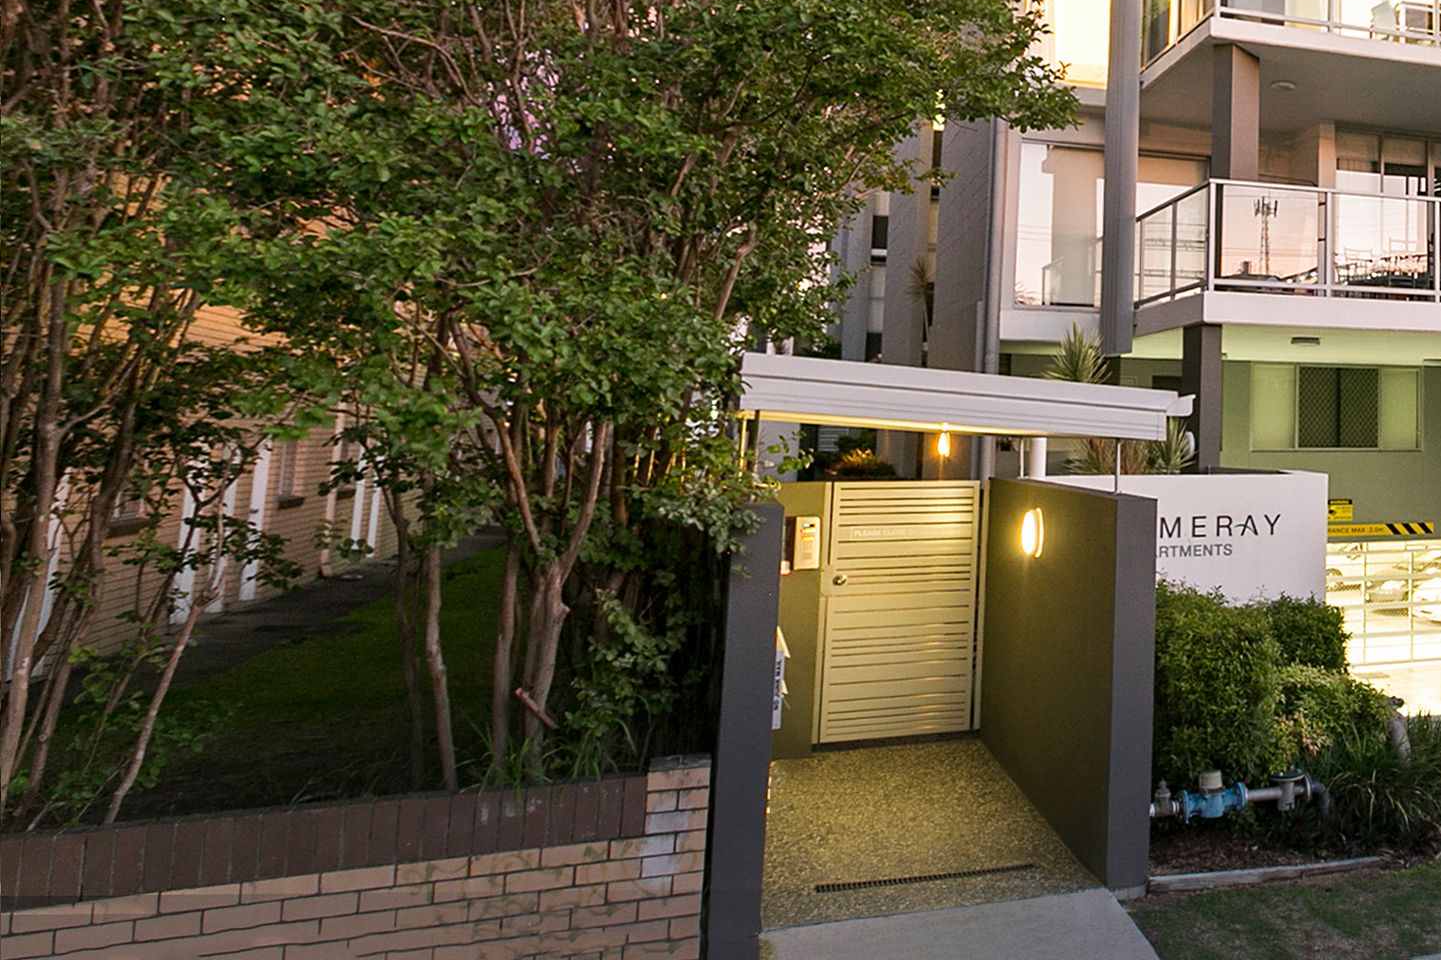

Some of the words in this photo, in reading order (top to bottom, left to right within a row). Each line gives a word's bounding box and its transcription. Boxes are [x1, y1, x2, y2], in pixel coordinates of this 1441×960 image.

[853, 528, 881, 537] PLEASE
[1160, 514, 1281, 538] MERAY
[1157, 543, 1233, 558] RTMENTS
